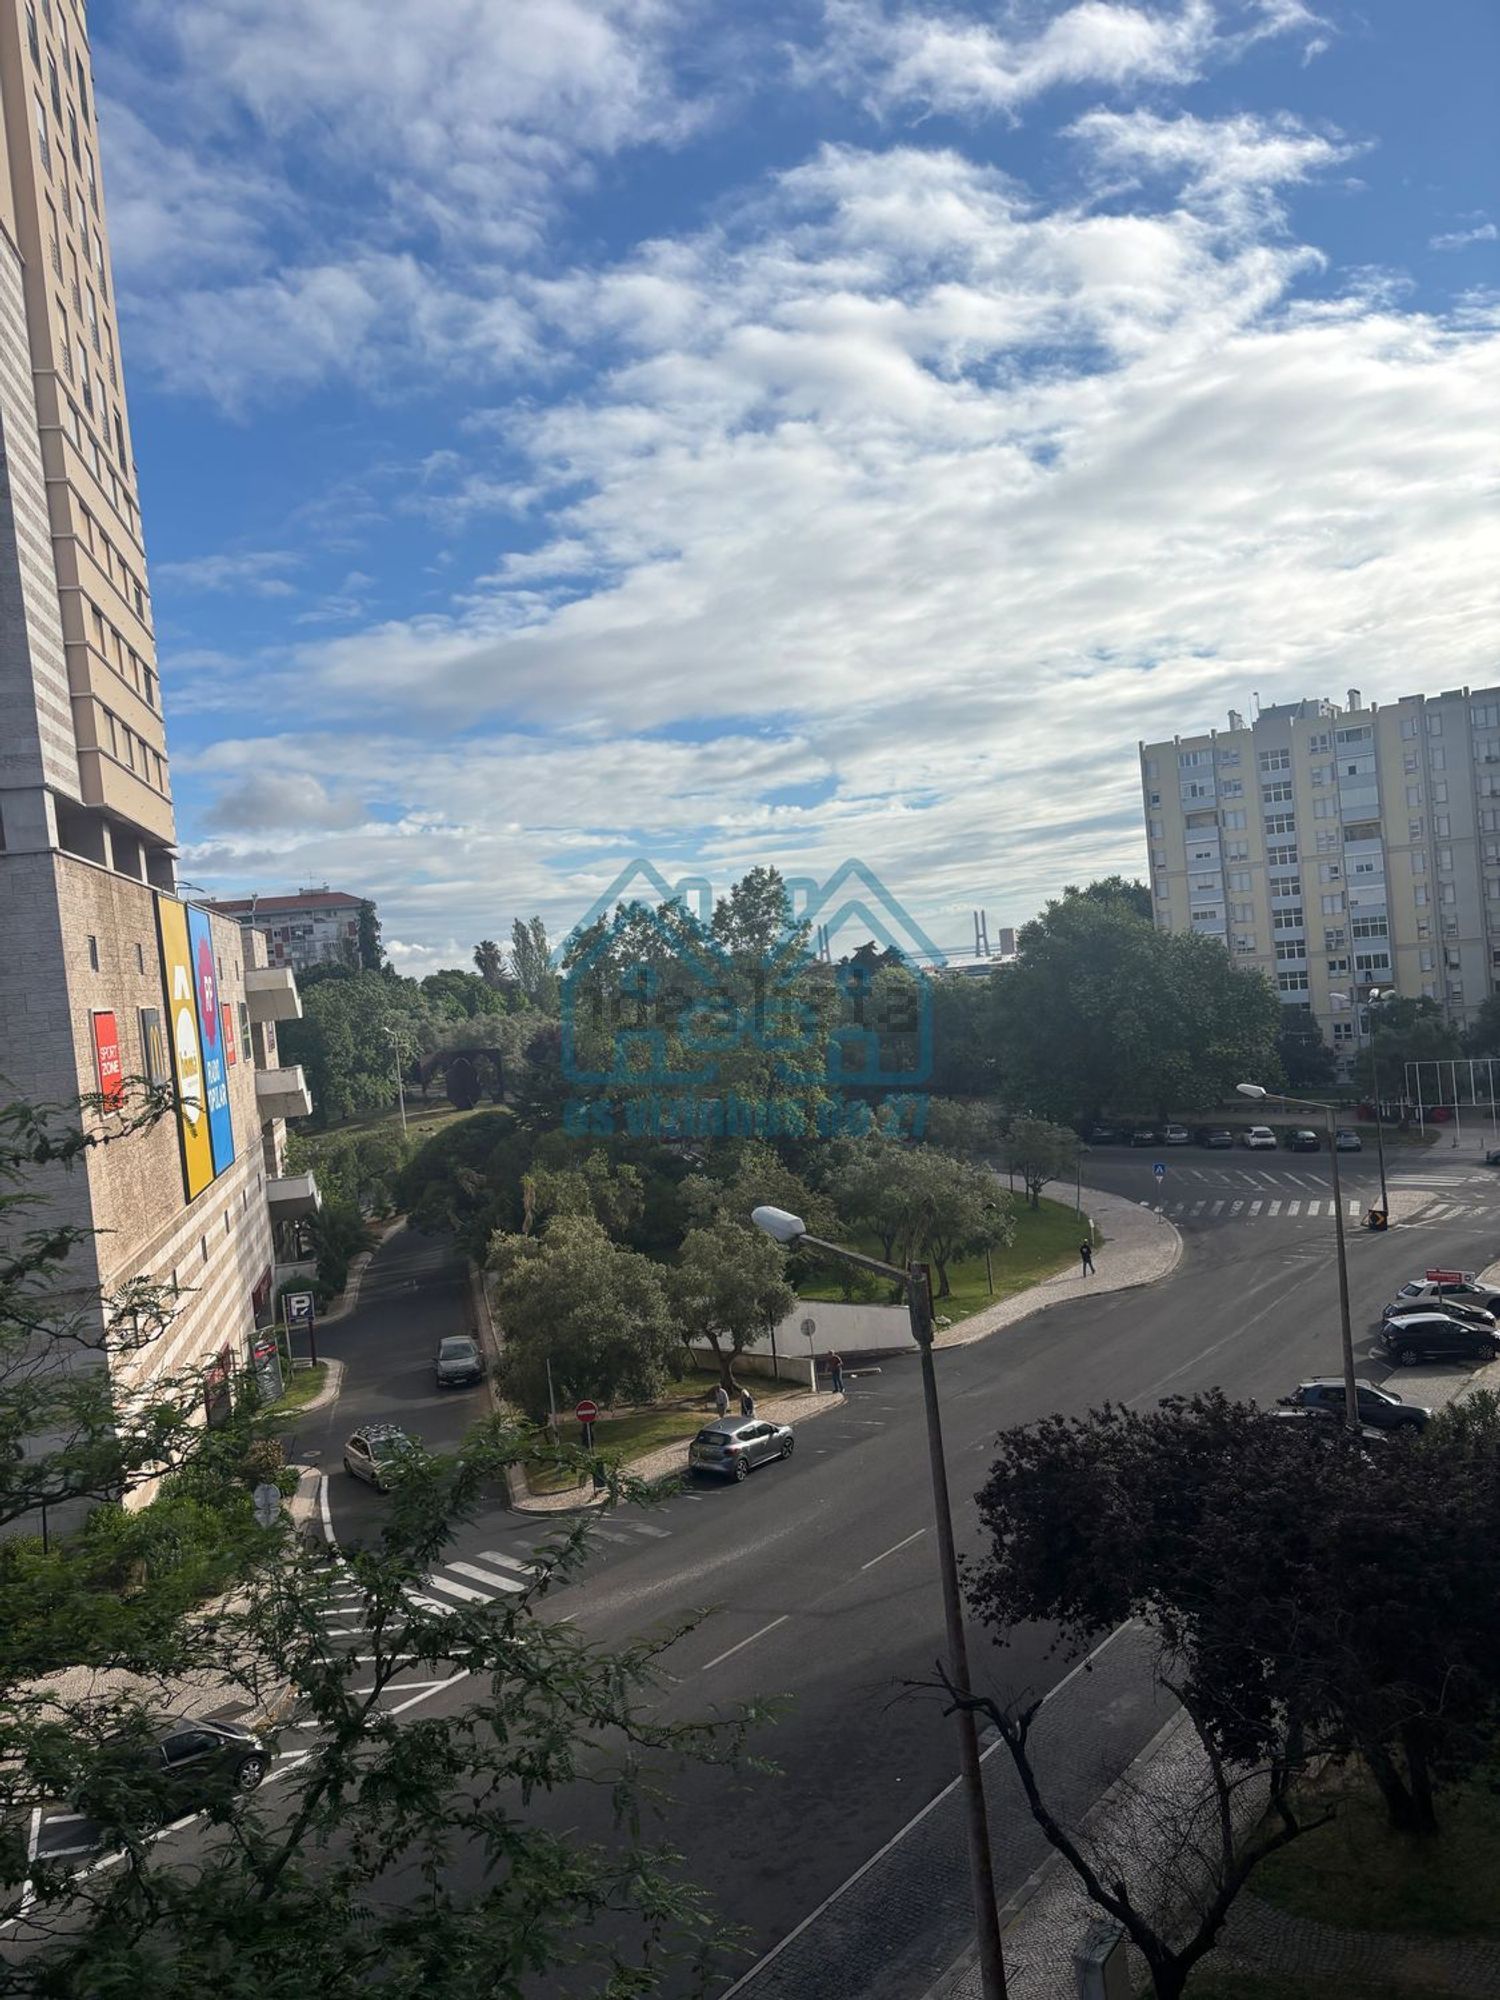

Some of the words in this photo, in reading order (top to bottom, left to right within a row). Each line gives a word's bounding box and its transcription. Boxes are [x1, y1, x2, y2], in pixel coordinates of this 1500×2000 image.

[99, 1045, 118, 1060] SPORT
[101, 1060, 120, 1076] ZONE
[290, 1295, 311, 1317] P
